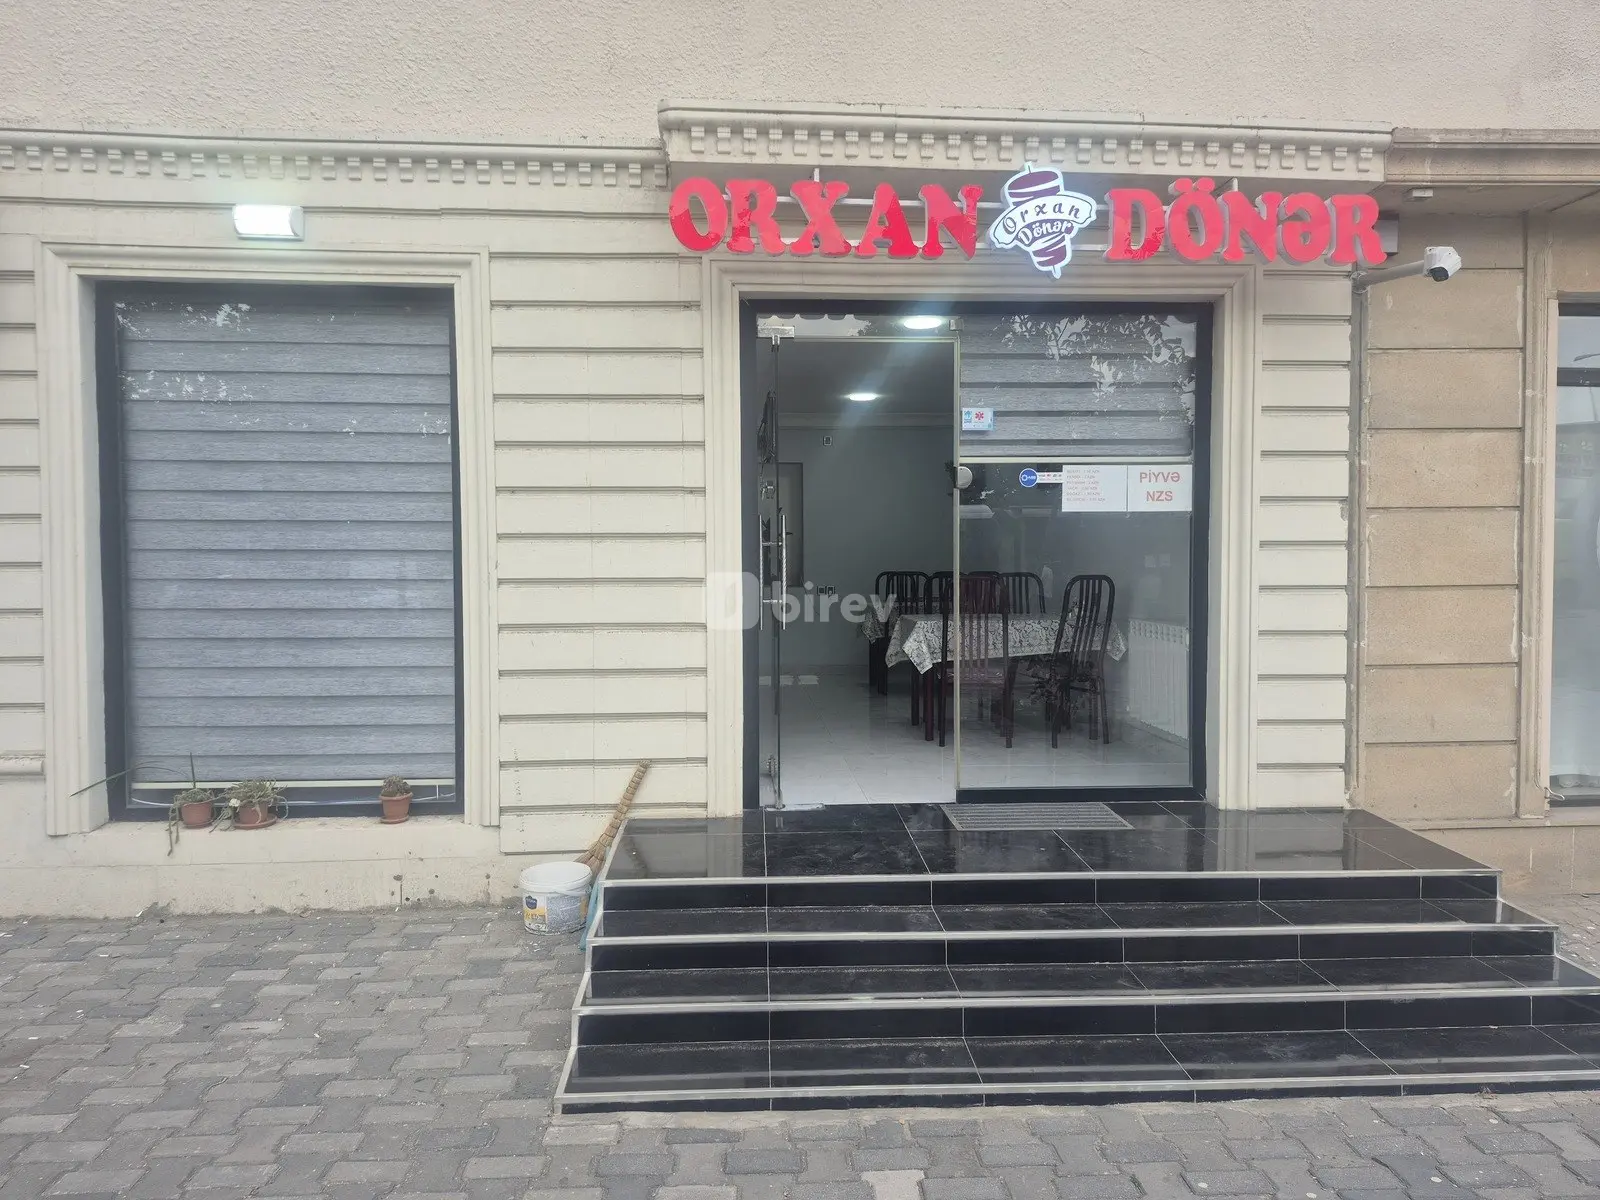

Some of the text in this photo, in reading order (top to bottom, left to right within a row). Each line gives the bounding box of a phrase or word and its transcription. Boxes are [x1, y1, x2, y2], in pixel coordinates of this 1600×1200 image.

[669, 177, 1388, 265] ORXAN DÖNƏR
[1003, 202, 1080, 235] Orxan
[1018, 220, 1072, 245] Dönər
[1139, 469, 1181, 483] PİYVƏ
[1146, 490, 1173, 502] NZS
